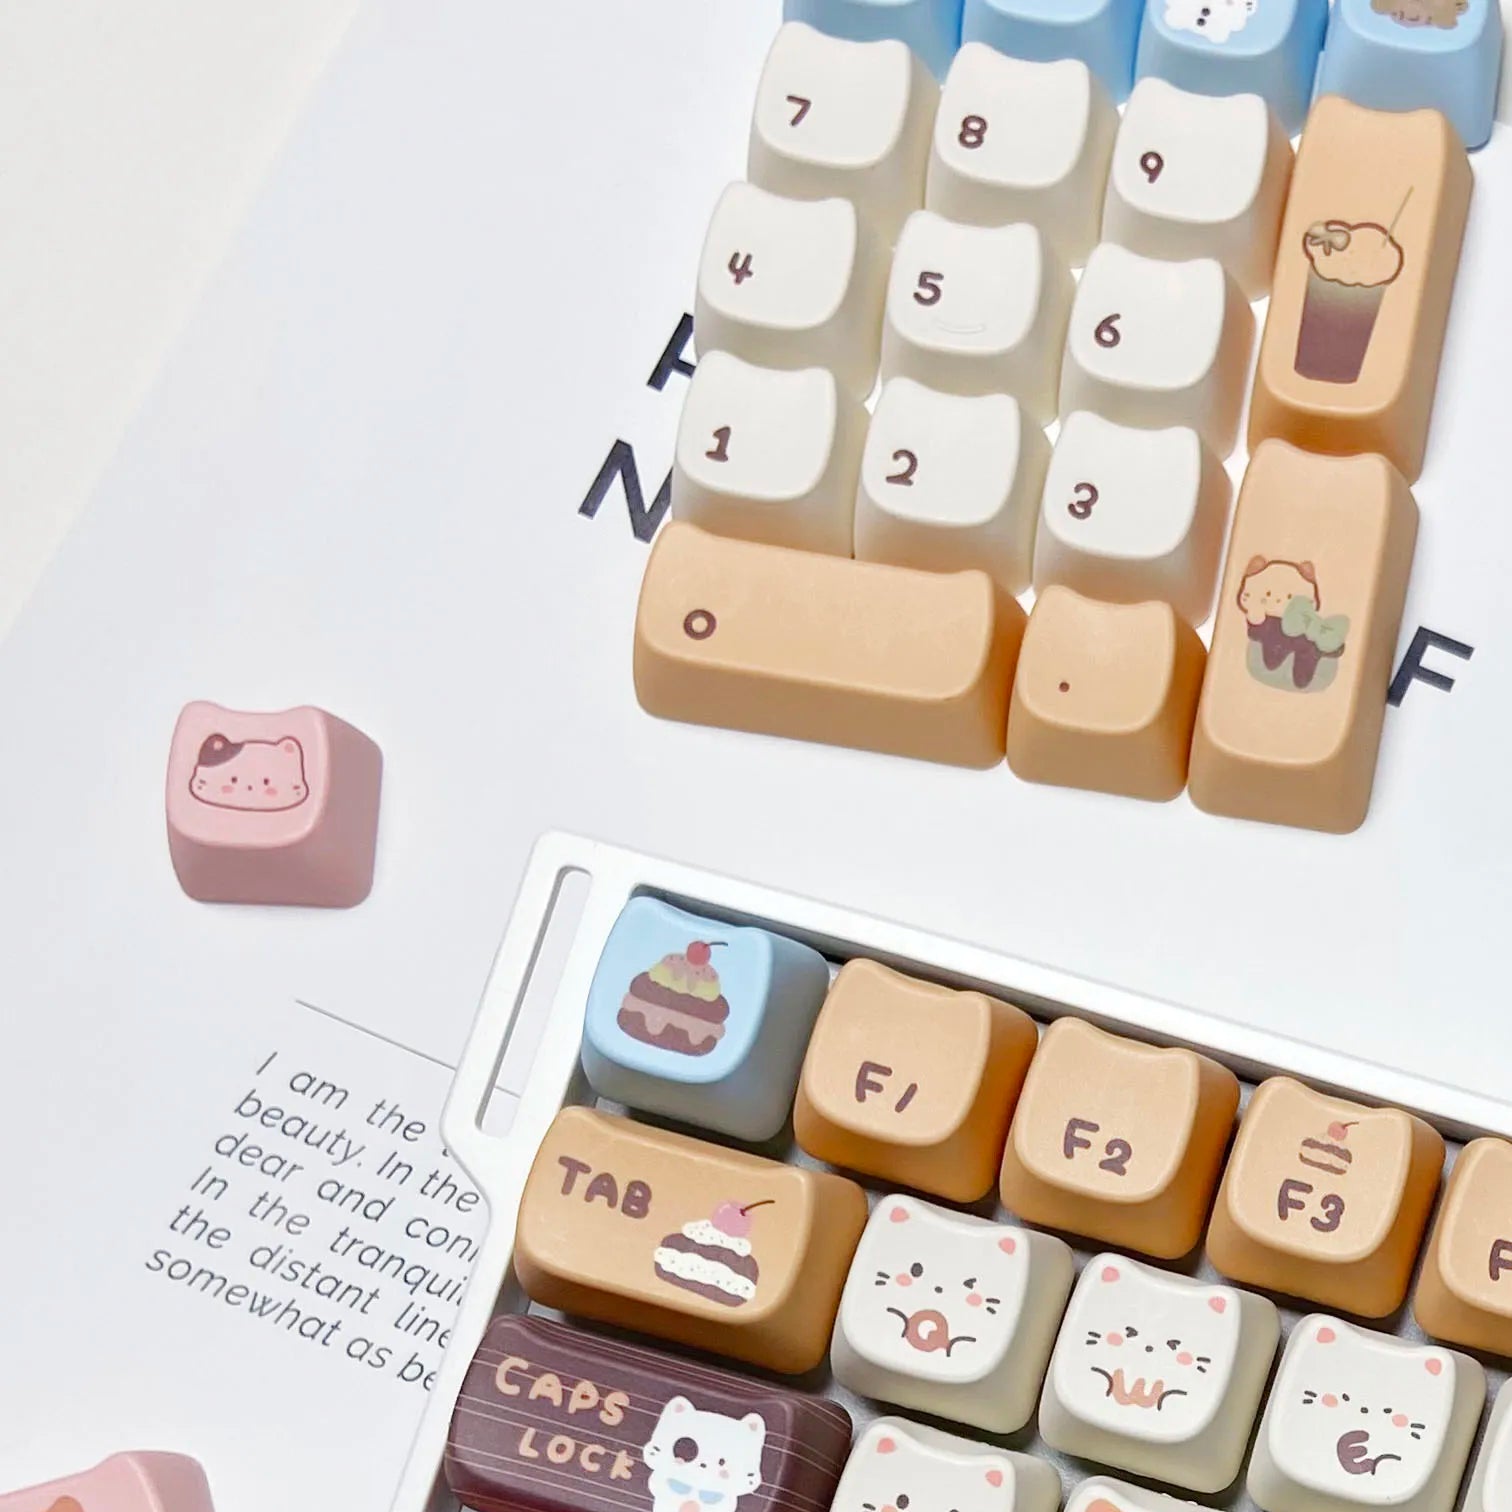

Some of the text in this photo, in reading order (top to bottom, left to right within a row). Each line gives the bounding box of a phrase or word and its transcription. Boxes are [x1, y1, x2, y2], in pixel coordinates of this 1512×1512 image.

[786, 94, 812, 127] 7
[959, 115, 988, 148] 8
[1139, 151, 1164, 184] 9
[728, 252, 753, 284] 4
[914, 272, 944, 305] 5
[1094, 312, 1122, 348] 6
[705, 425, 731, 462] 1
[886, 451, 918, 486] 2
[1069, 483, 1099, 519] 3
[256, 1051, 426, 1144] I am the
[855, 1061, 917, 1113] F1
[234, 1090, 480, 1213] beauty. In the
[1063, 1117, 1133, 1176] F2
[215, 1130, 305, 1183] dear
[317, 1178, 396, 1223] and
[558, 1155, 653, 1220] TAB
[1278, 1179, 1346, 1233] F3
[169, 1205, 231, 1250] the
[249, 1244, 383, 1315] distant
[191, 1166, 468, 1306] In the tranqui
[145, 1247, 342, 1347] somewhat
[346, 1336, 392, 1370] as
[907, 1309, 949, 1353] Q
[496, 1356, 630, 1425] CAPS
[519, 1427, 634, 1480] LOCK
